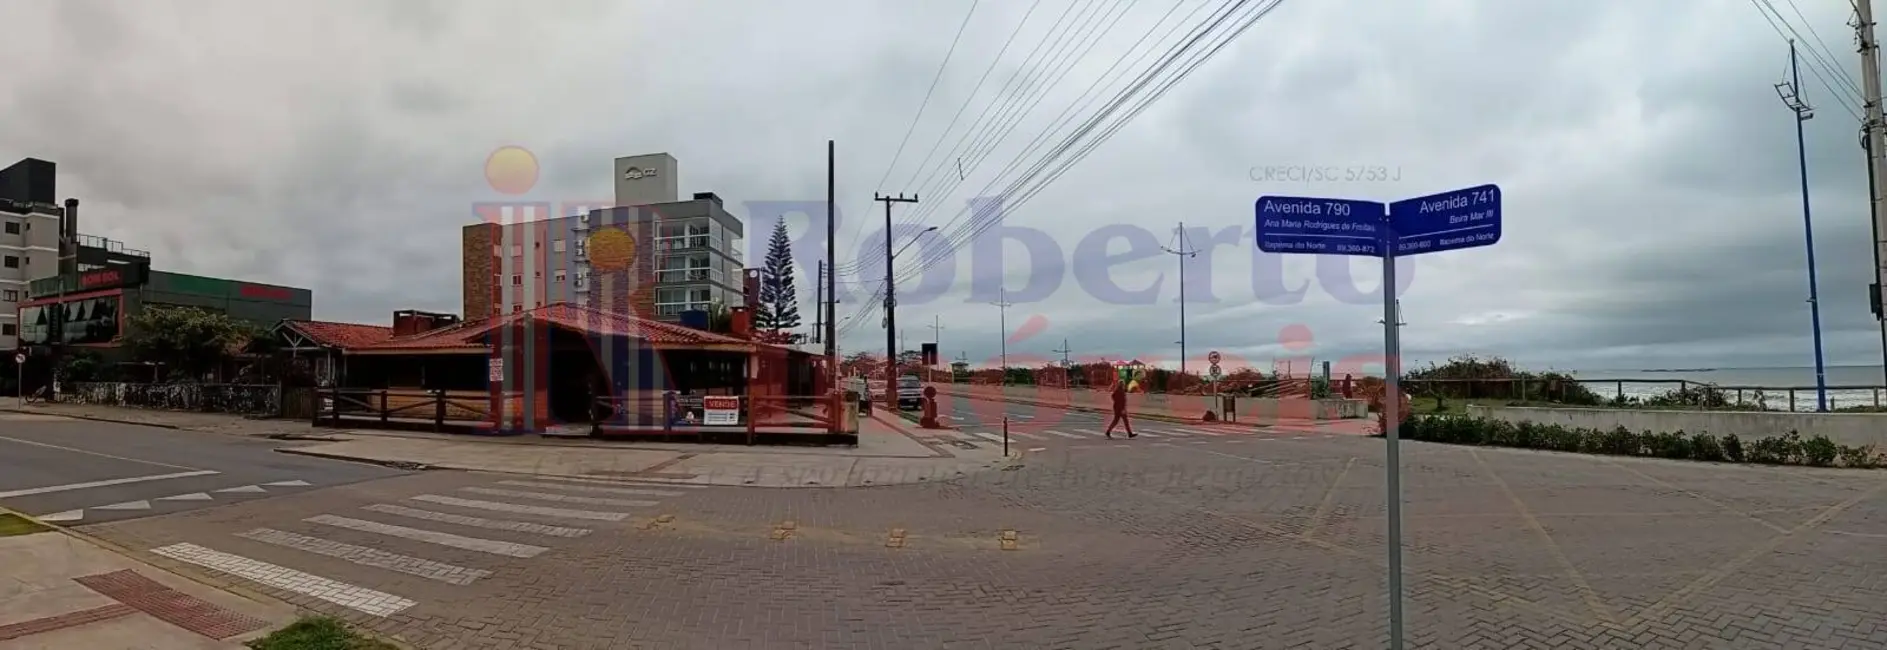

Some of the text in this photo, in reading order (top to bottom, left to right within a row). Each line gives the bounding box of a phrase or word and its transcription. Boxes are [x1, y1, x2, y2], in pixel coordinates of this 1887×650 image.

[1263, 199, 1351, 216] Avenida 790
[1420, 189, 1494, 213] Avenida 741
[1263, 219, 1280, 228] Ana
[1281, 219, 1302, 228] Maria
[1303, 220, 1340, 231] Rodrigues
